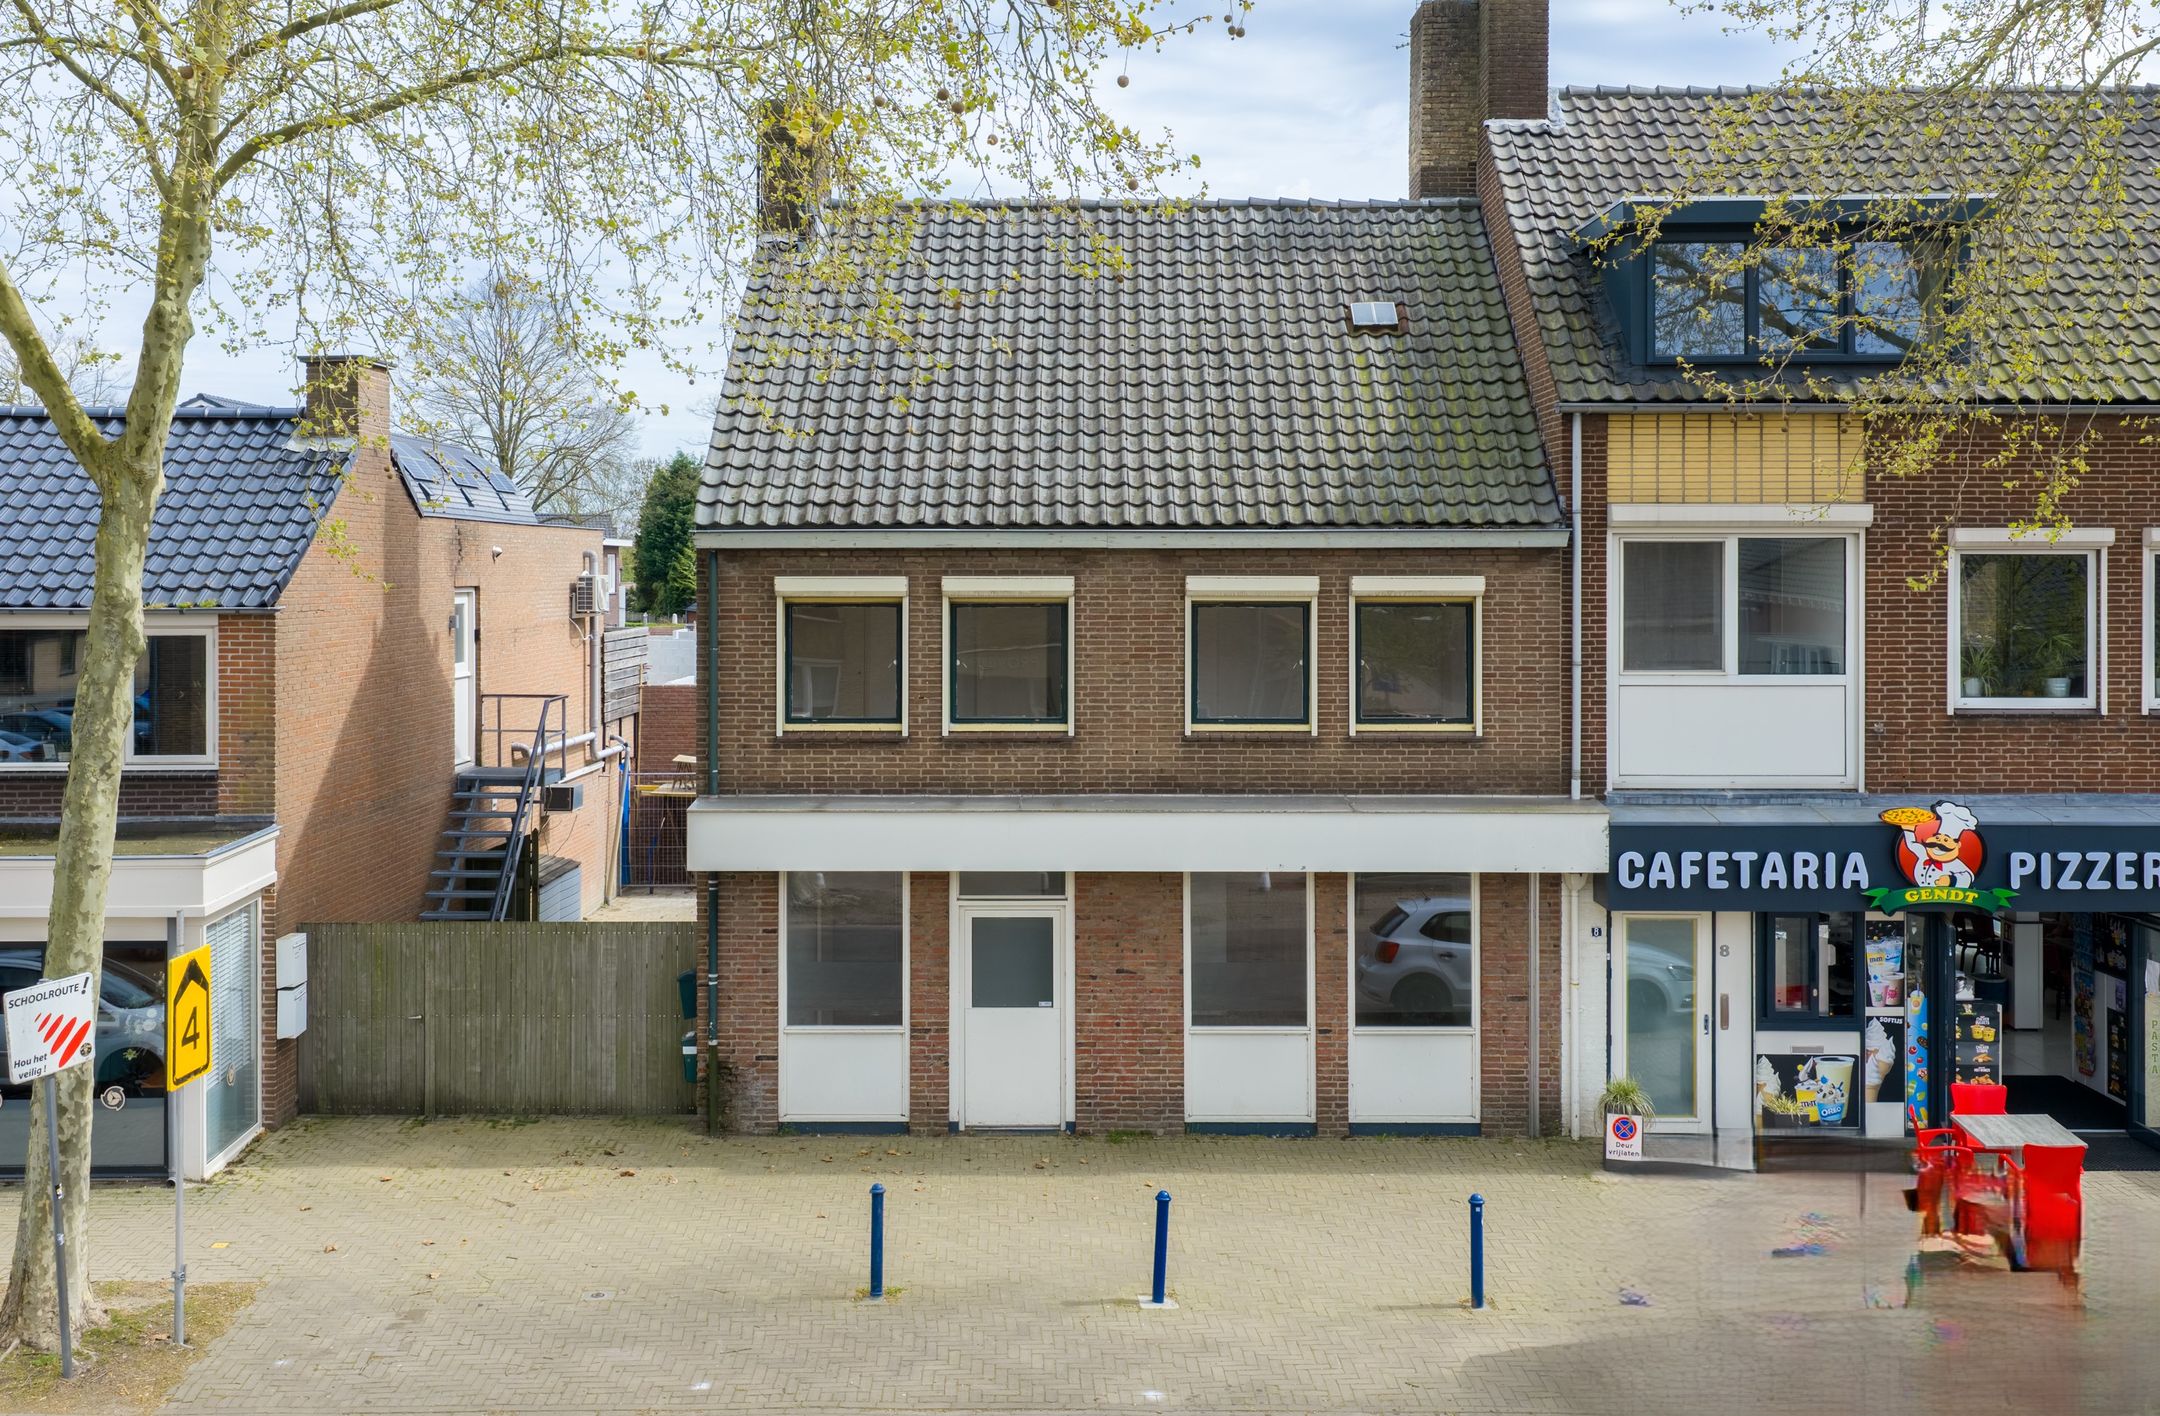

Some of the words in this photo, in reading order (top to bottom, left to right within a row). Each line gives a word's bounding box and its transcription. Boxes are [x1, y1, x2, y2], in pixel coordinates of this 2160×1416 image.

[1617, 851, 1870, 890] CAFETARIA
[2009, 851, 2160, 890] PIZZER
[1904, 888, 1979, 904] GENDT
[1593, 927, 1600, 937] 8
[1719, 944, 1730, 957] 8
[181, 1006, 200, 1050] 4
[2151, 1020, 2159, 1074] PASTA
[13, 1058, 32, 1069] Hou
[33, 1053, 48, 1063] het
[1821, 1106, 1842, 1117] OREO
[1615, 1141, 1634, 1149] Deur
[1608, 1149, 1640, 1158] vrijlaten
